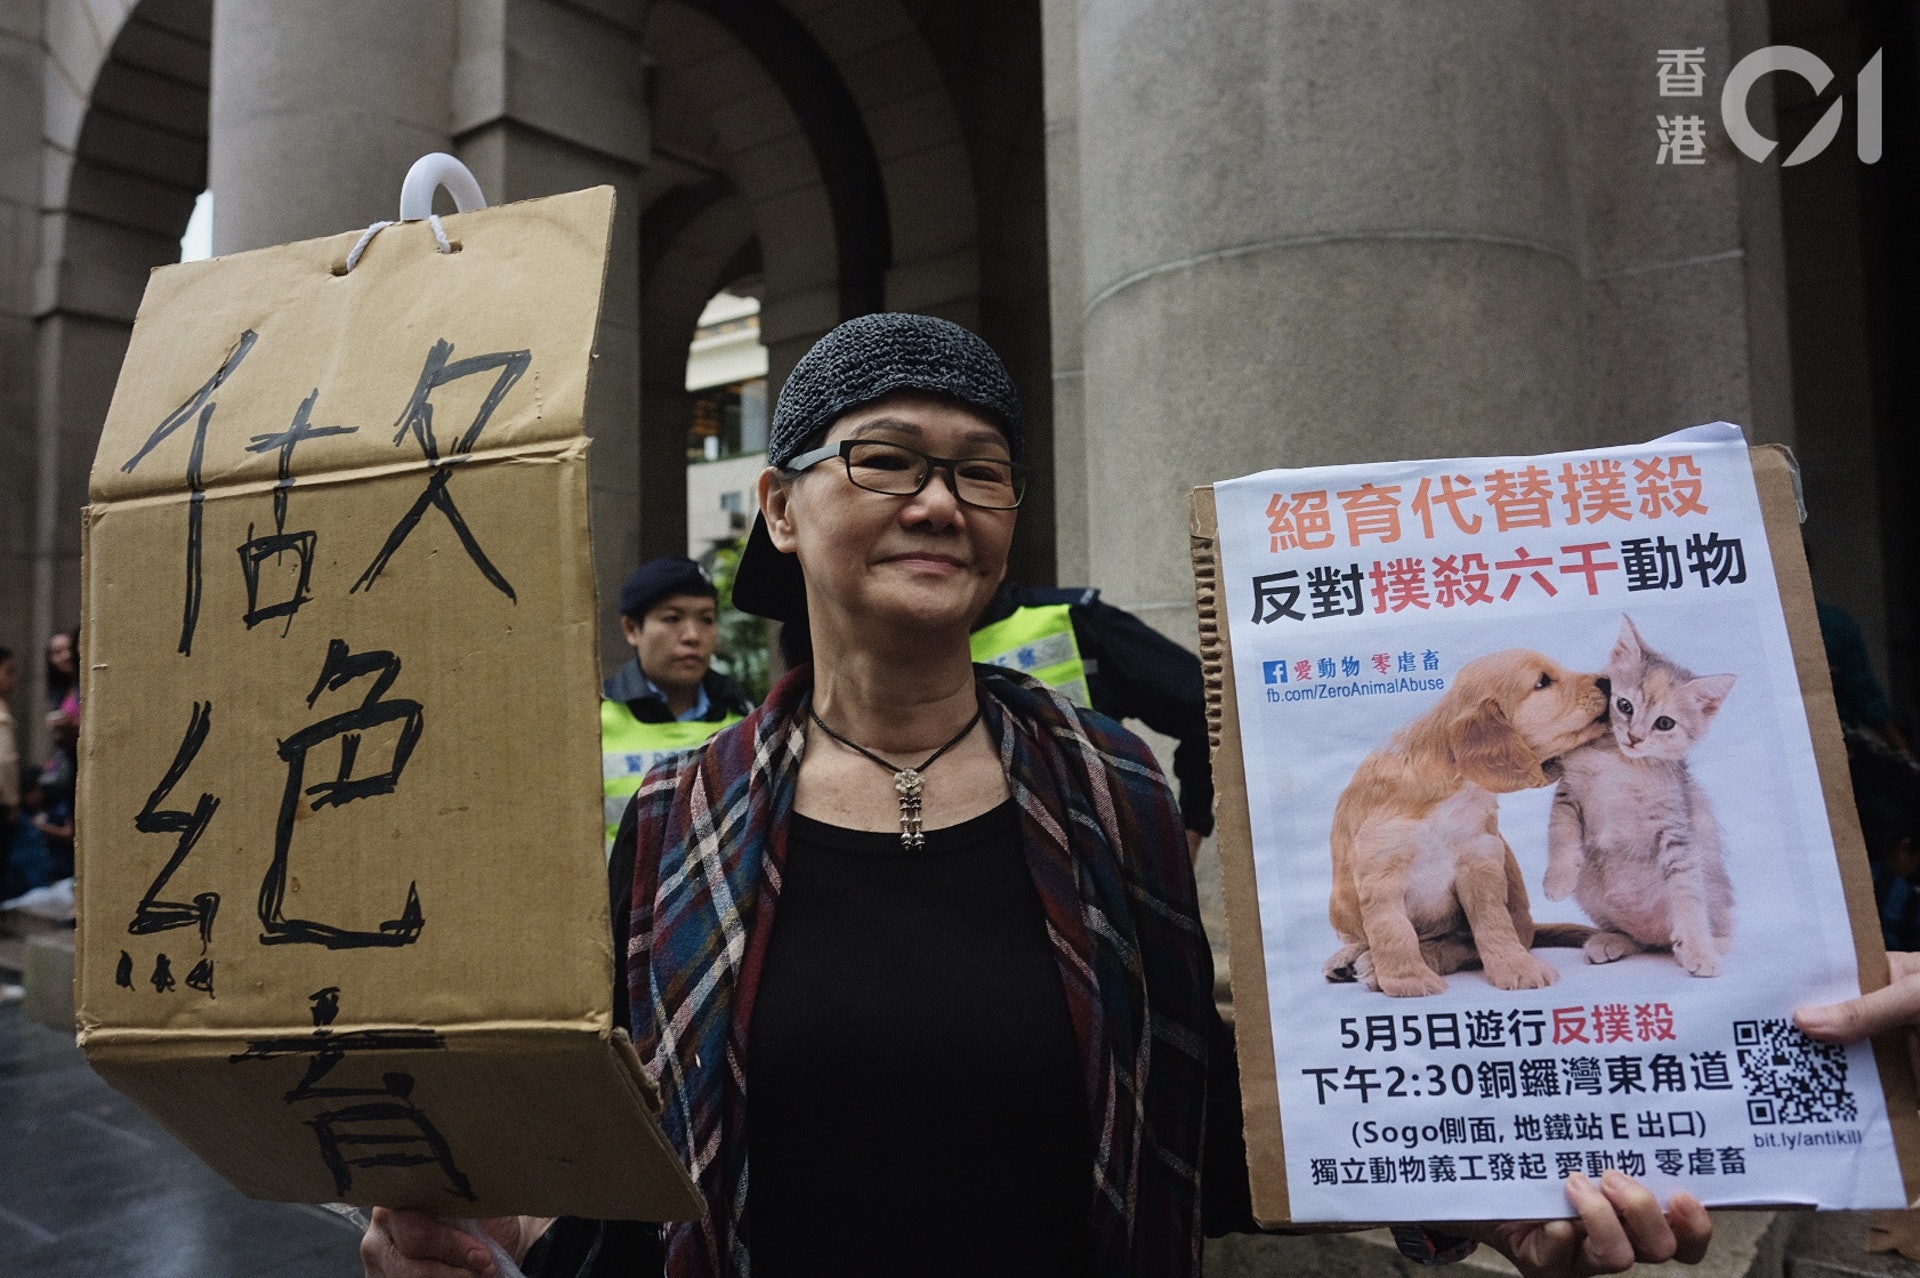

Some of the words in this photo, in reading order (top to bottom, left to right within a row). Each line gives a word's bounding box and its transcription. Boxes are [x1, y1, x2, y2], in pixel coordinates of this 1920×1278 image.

[1265, 454, 1708, 554] 絕育代替撲殺
[1250, 531, 1748, 625] 反對撲殺六千動物
[1294, 655, 1360, 682] 愛動物
[1371, 649, 1440, 675] 零虐畜
[1266, 677, 1445, 703] fb.com/ZeroAnimalAbuse
[1340, 1002, 1677, 1052] 5月5日遊行反撲殺
[1301, 1050, 1734, 1105] 下午2:30銅鑼灣東角道
[1753, 1129, 1863, 1150] bit.ly/antikill
[1310, 1151, 1549, 1186] 獨立動物義工發起
[1555, 1148, 1647, 1180] 愛動物
[1654, 1147, 1747, 1178] 零虐畜
